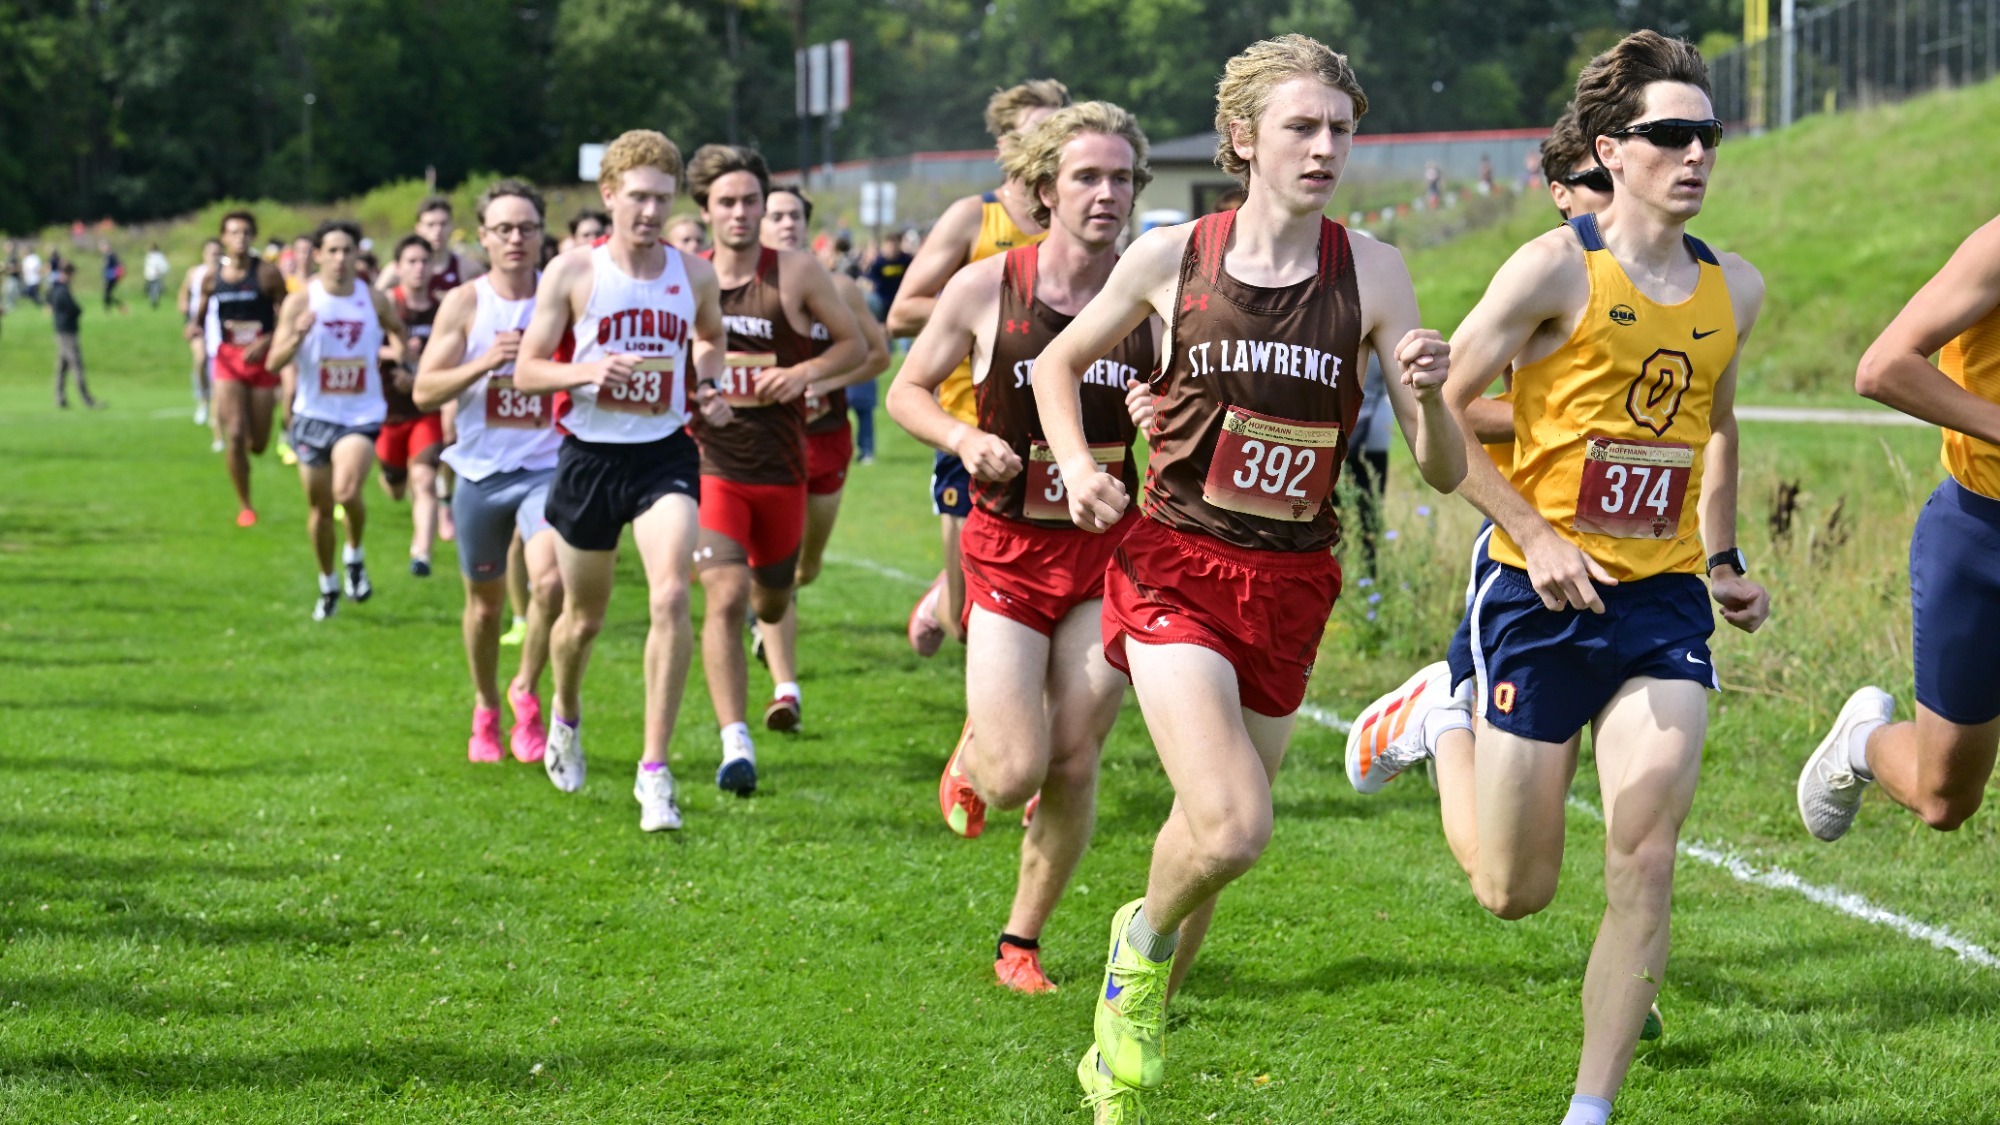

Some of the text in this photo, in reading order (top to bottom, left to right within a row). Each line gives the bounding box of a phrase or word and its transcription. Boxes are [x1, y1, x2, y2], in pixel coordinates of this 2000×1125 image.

[1189, 339, 1342, 389] ST. LAWRENCE
[497, 387, 543, 418] 334
[1625, 348, 1693, 437] Q
[1248, 421, 1292, 435] HOFFMANN
[1232, 440, 1316, 497] 392
[1609, 446, 1648, 457] HOFFMANN
[1601, 464, 1672, 516] 374
[1494, 681, 1517, 715] Q
